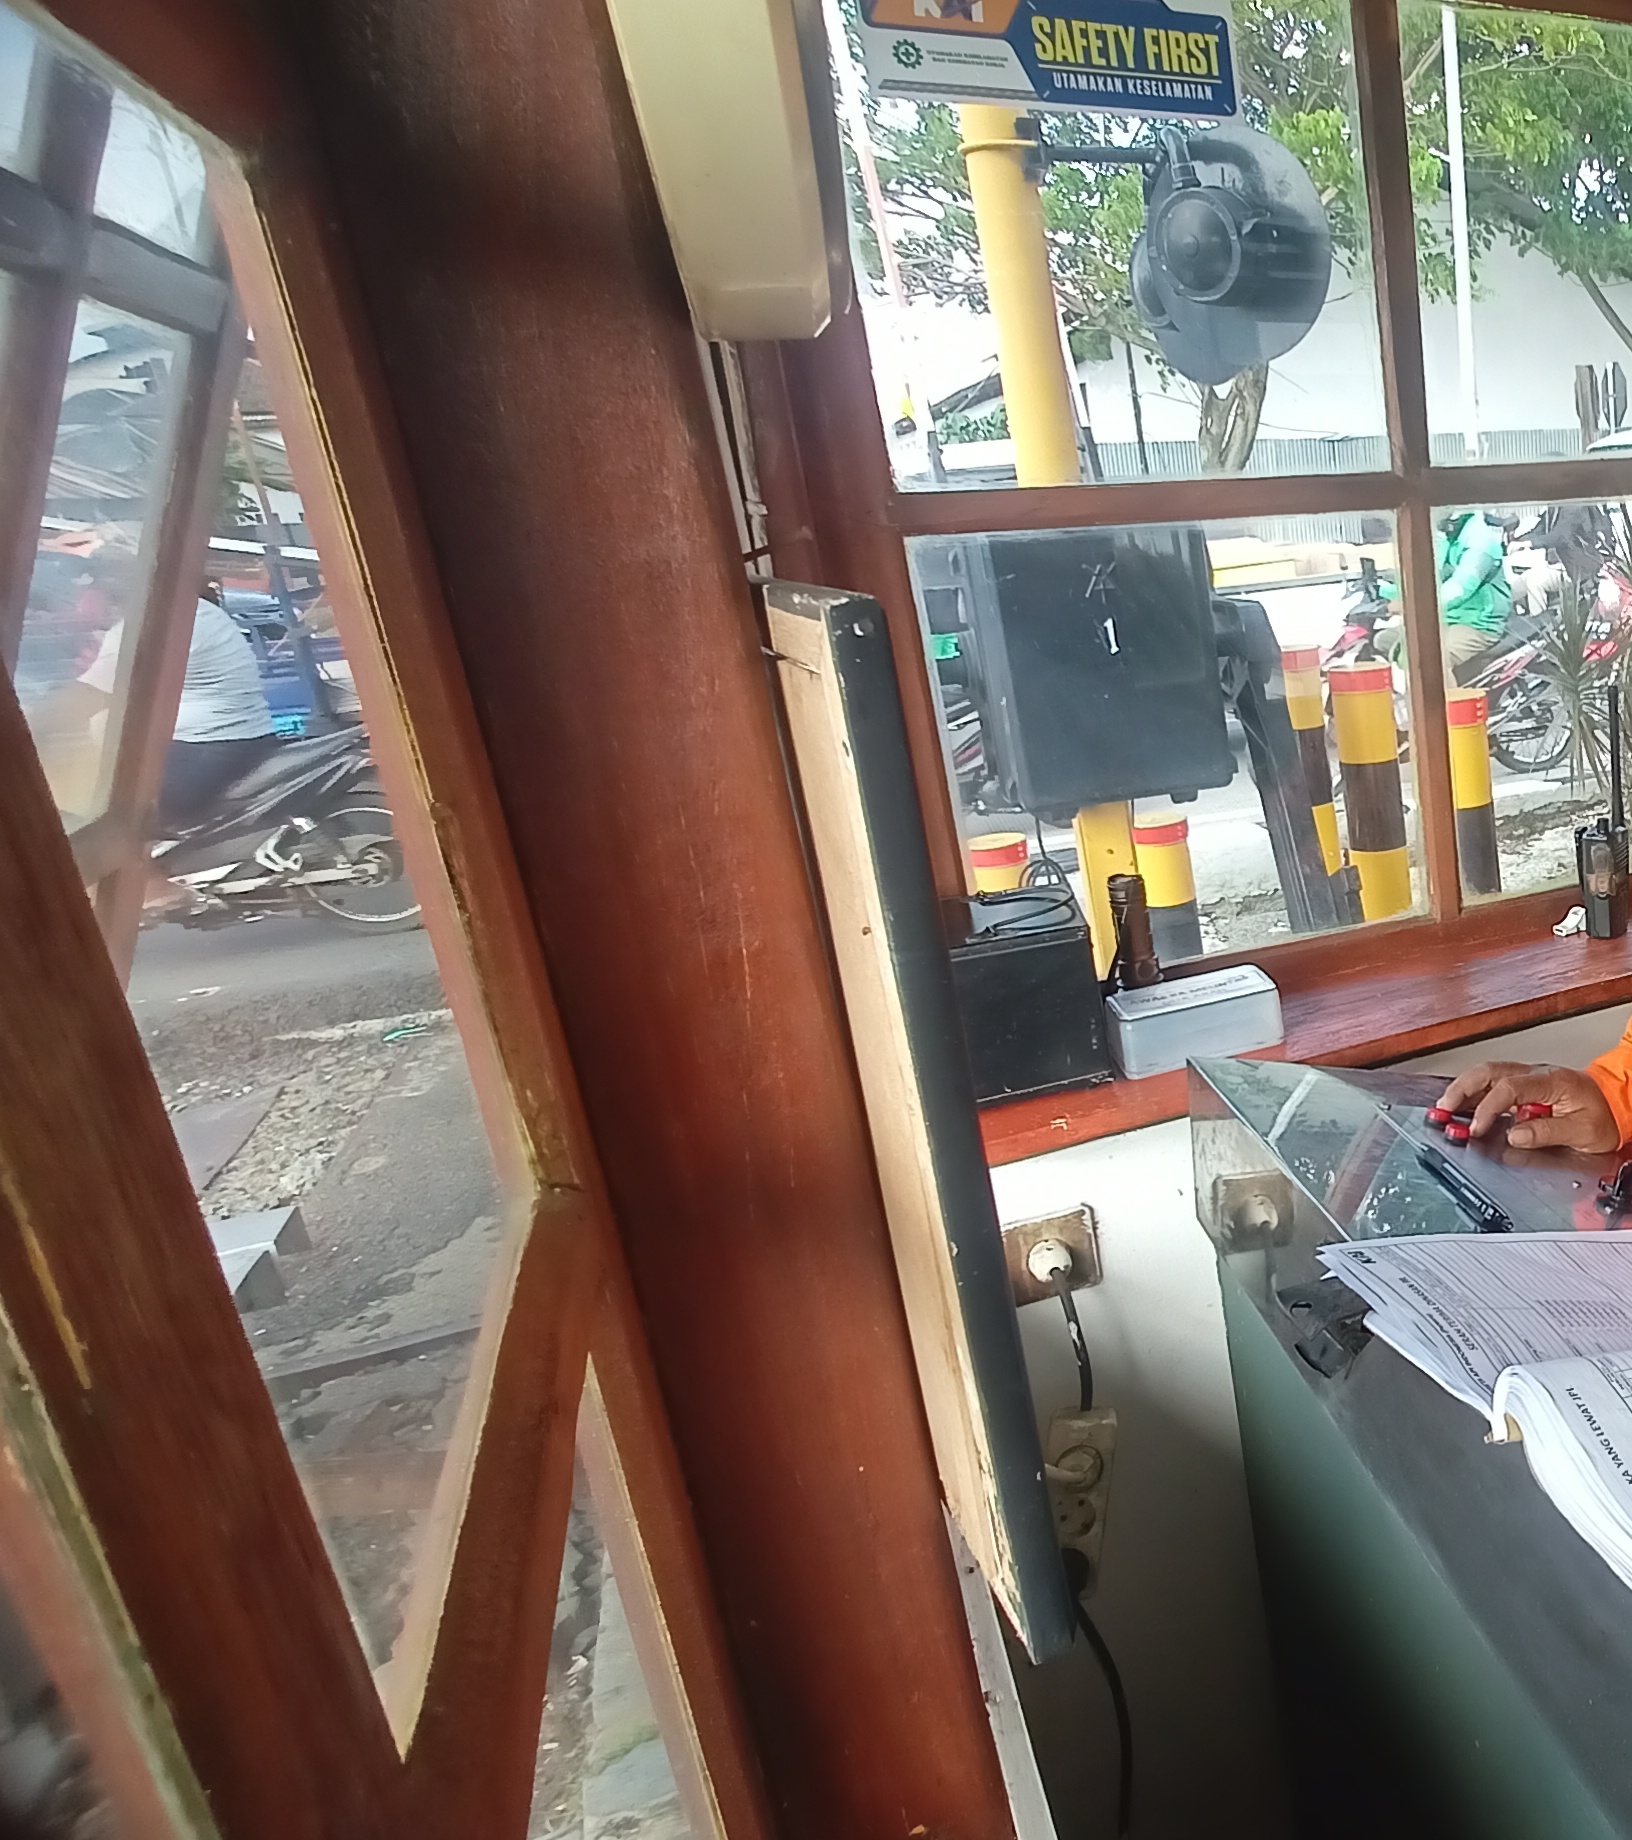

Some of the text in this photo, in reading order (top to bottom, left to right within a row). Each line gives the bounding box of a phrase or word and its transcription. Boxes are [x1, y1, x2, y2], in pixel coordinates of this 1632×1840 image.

[1031, 16, 1220, 77] SAFETY FIRST
[1052, 71, 1213, 101] UTAMAKAN KESELAMATAN
[1600, 1439, 1624, 1468] YANG
